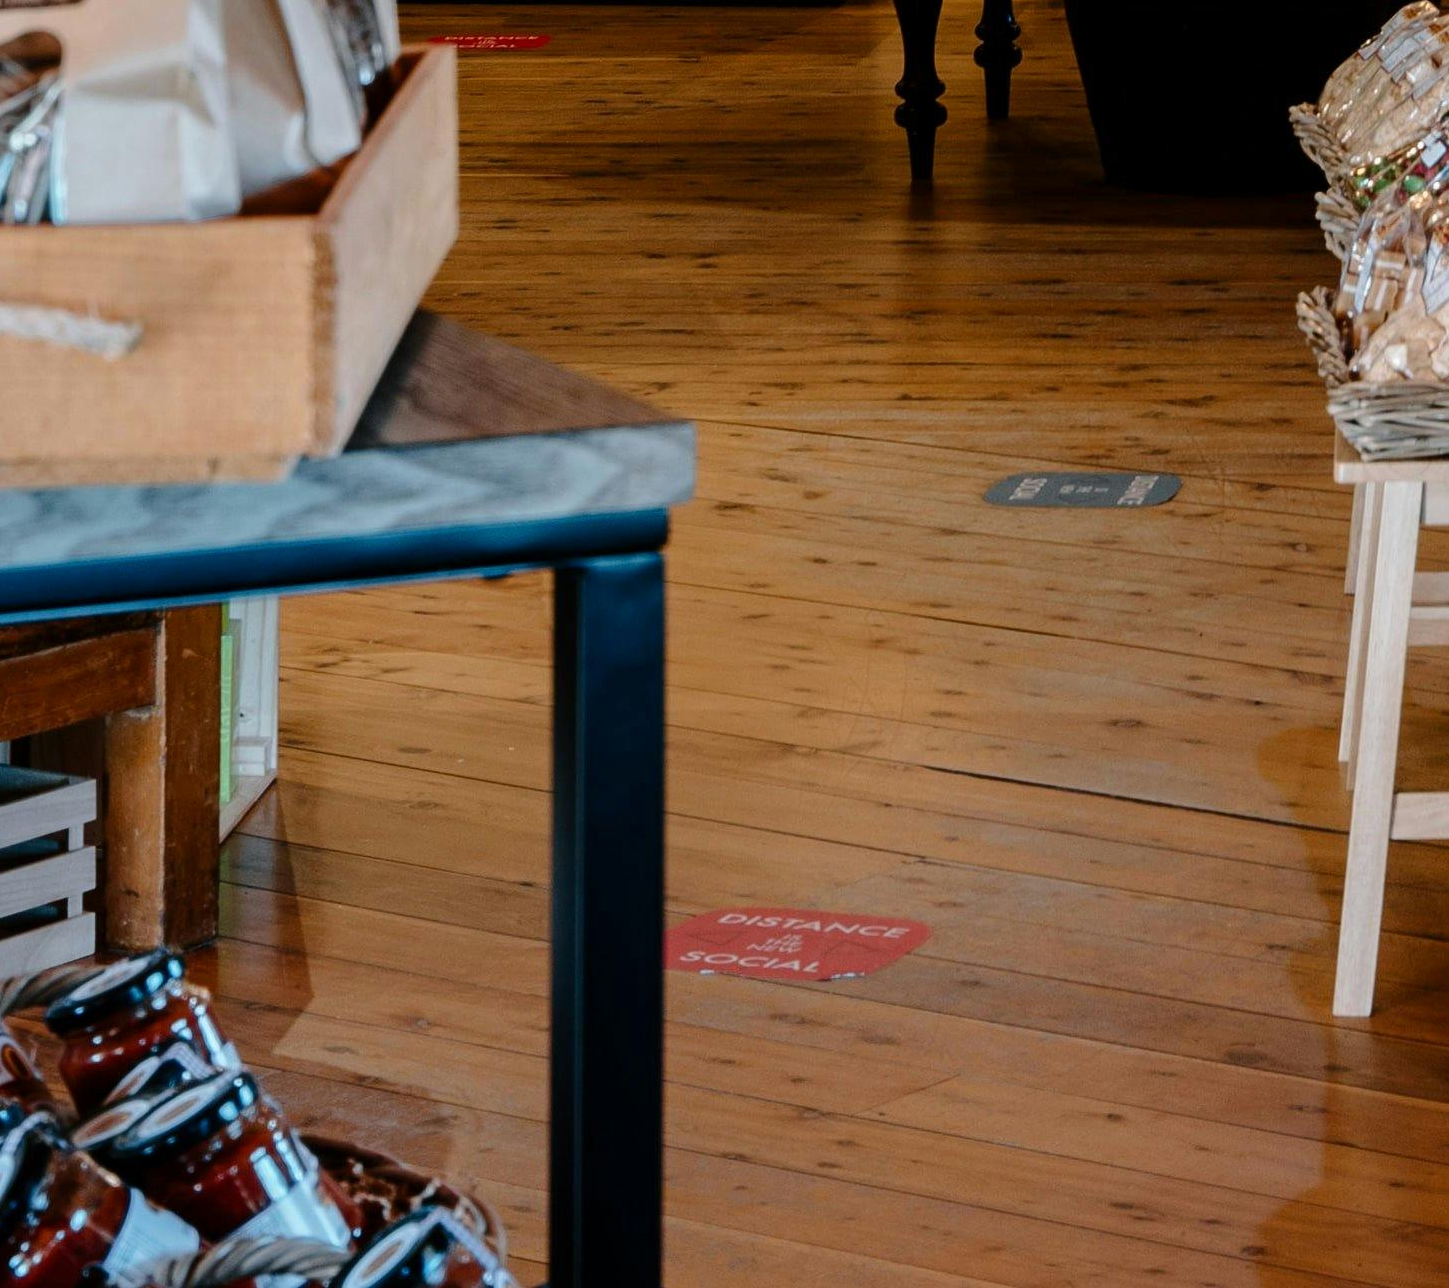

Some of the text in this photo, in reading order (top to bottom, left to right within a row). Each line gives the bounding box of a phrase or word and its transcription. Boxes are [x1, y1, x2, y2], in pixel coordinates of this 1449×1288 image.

[718, 913, 910, 939] DISTANCE
[747, 944, 802, 953] NEW
[679, 951, 820, 972] SOCIAL
